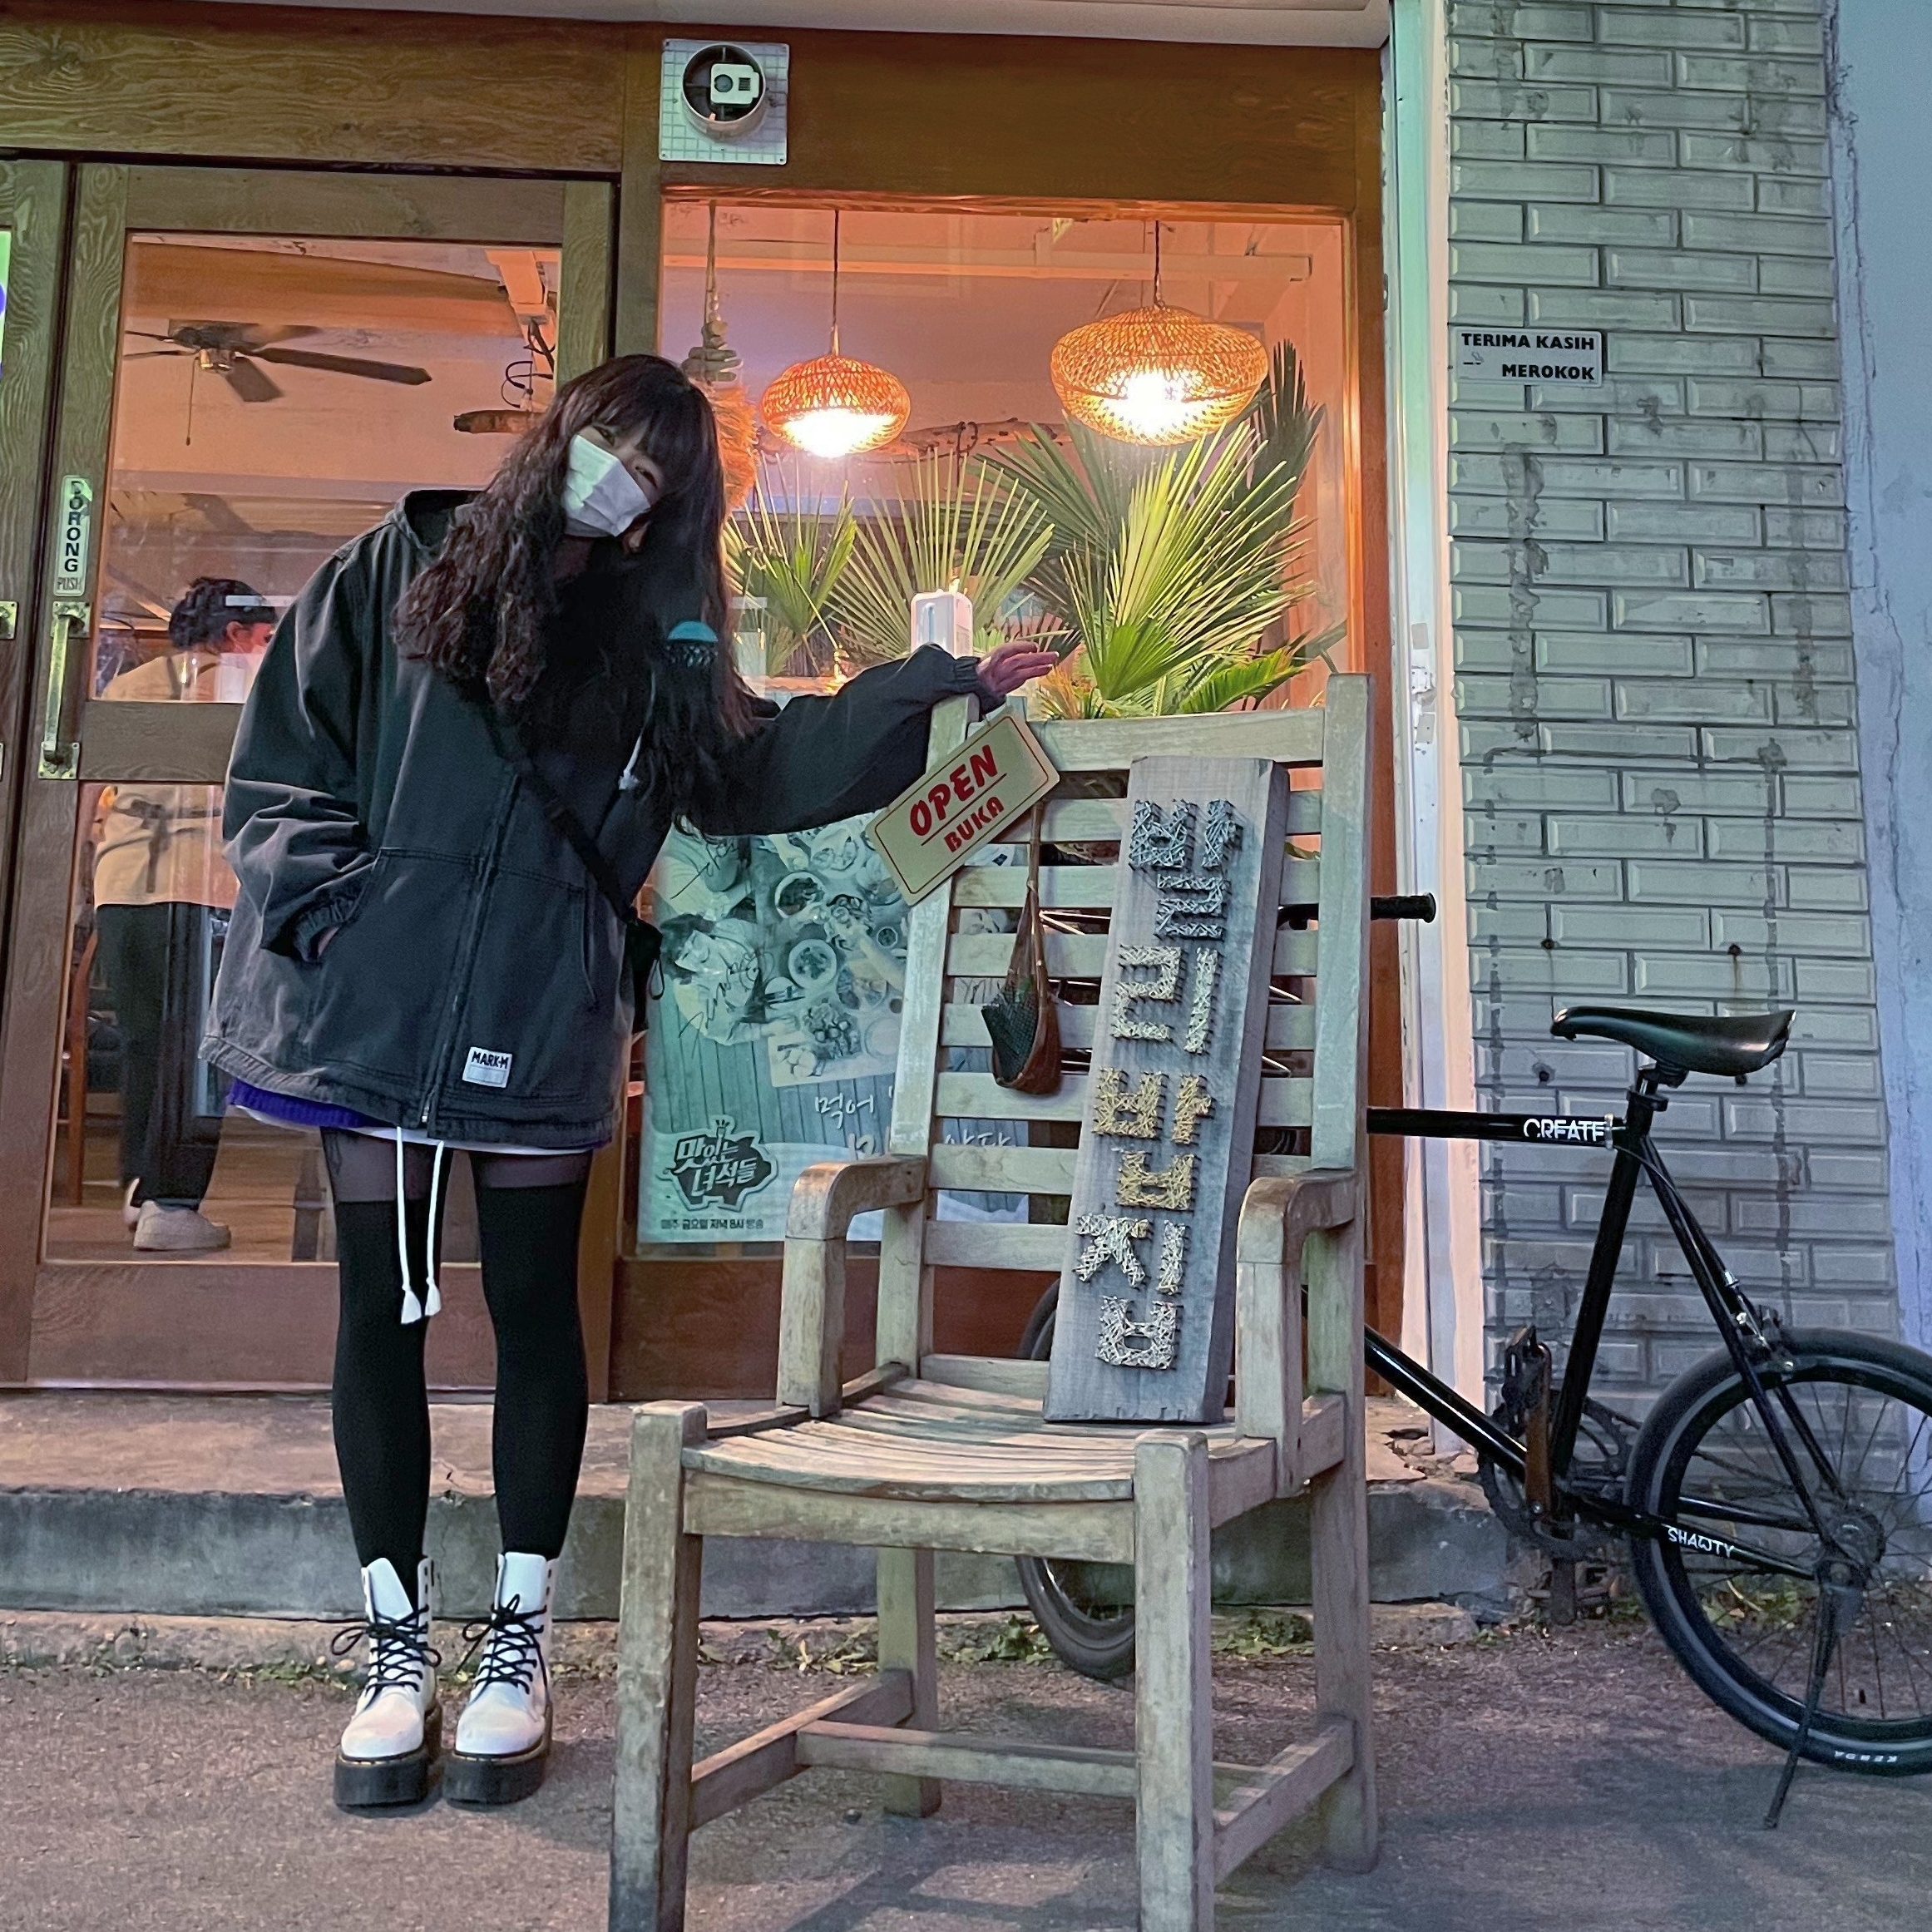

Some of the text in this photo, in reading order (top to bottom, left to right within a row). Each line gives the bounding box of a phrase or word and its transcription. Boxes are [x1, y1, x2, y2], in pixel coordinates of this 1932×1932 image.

[1461, 333, 1594, 350] TERIMA KASIH
[1502, 363, 1595, 380] MEROKOK
[64, 480, 85, 572] DORONG
[910, 744, 998, 836] OPEN
[943, 796, 1005, 853] BUKA
[1523, 1118, 1608, 1142] CREATE
[674, 1136, 739, 1174] 맛있는
[690, 1157, 758, 1197] 녀석들
